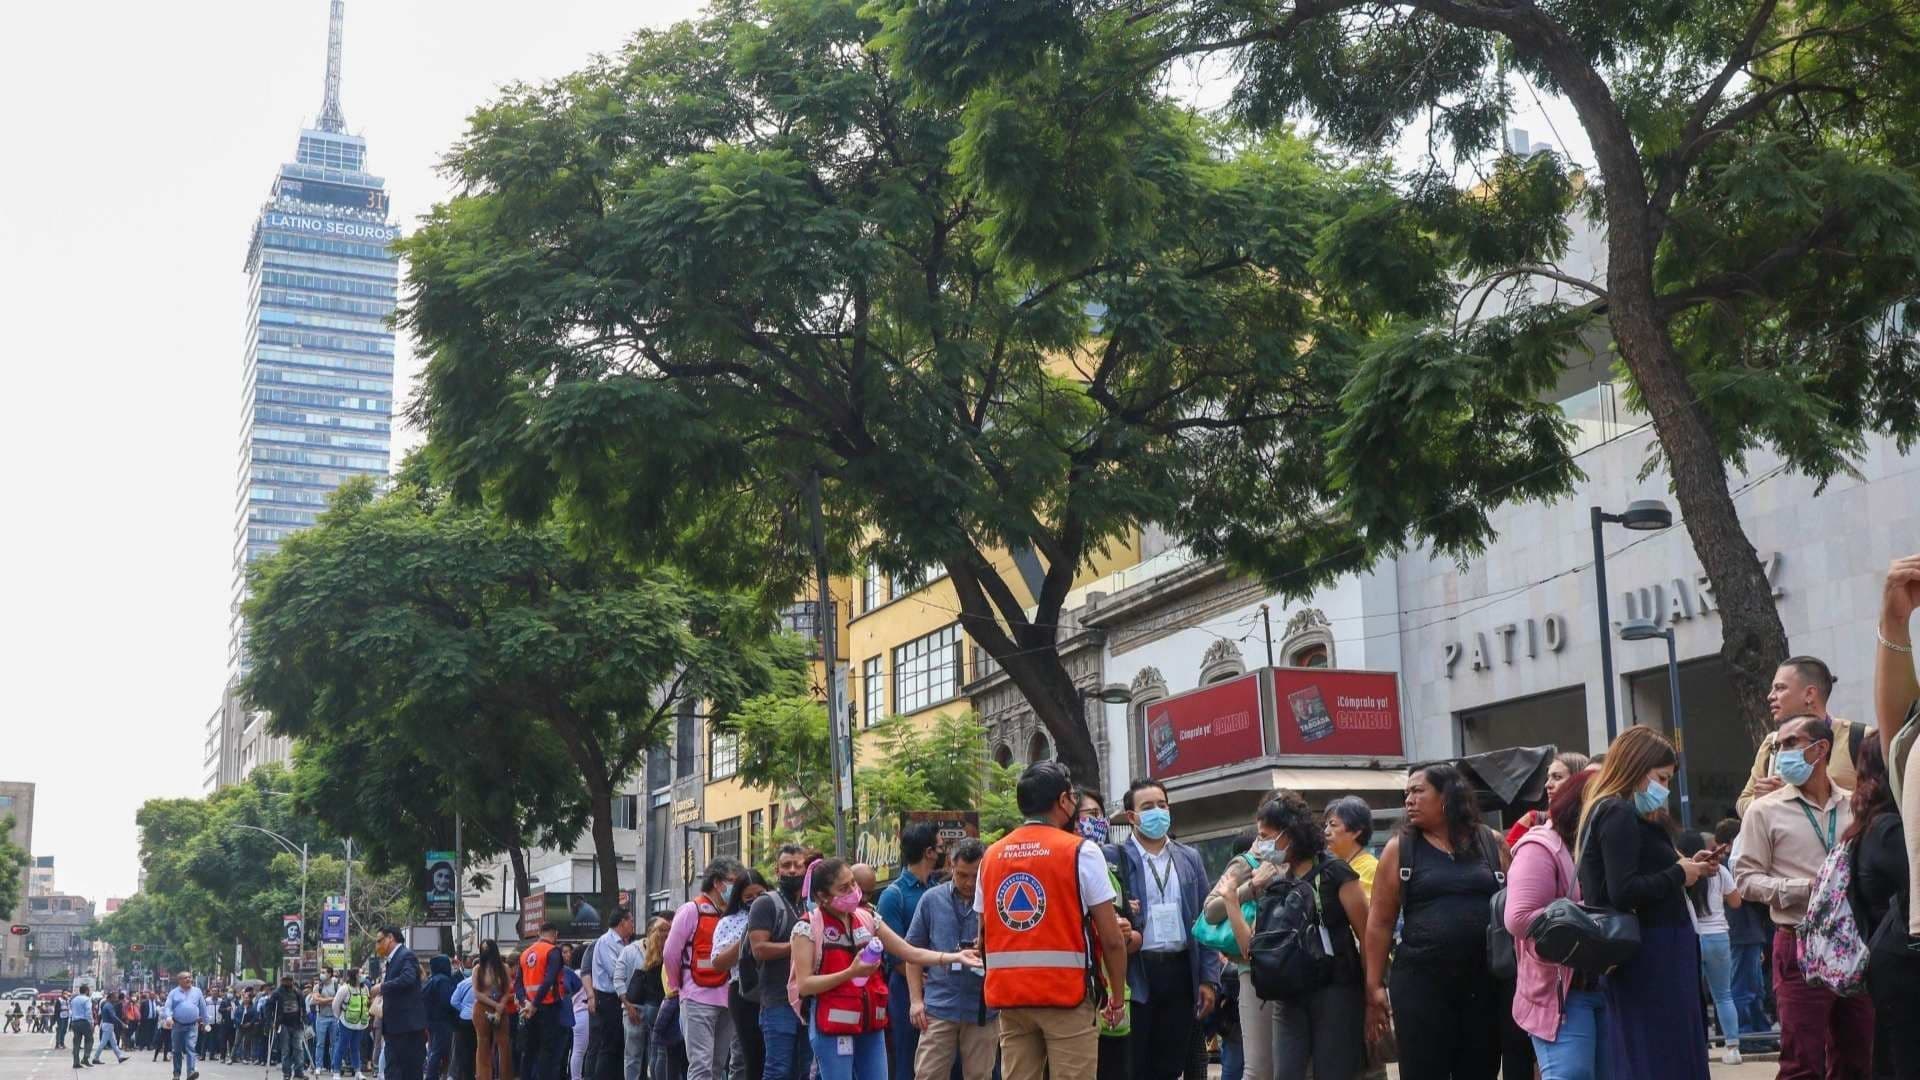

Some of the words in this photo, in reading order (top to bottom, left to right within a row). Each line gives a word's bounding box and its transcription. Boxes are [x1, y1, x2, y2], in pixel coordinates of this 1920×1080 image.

[271, 214, 322, 231] LATINO
[327, 222, 394, 240] SEGUROS
[1441, 613, 1567, 679] PATIO
[1613, 551, 1786, 625] JUARZ
[1337, 710, 1393, 730] CAMBIO
[1003, 848, 1050, 859] EVACUACIÓN
[1005, 842, 1041, 853] REPLIEGUE
